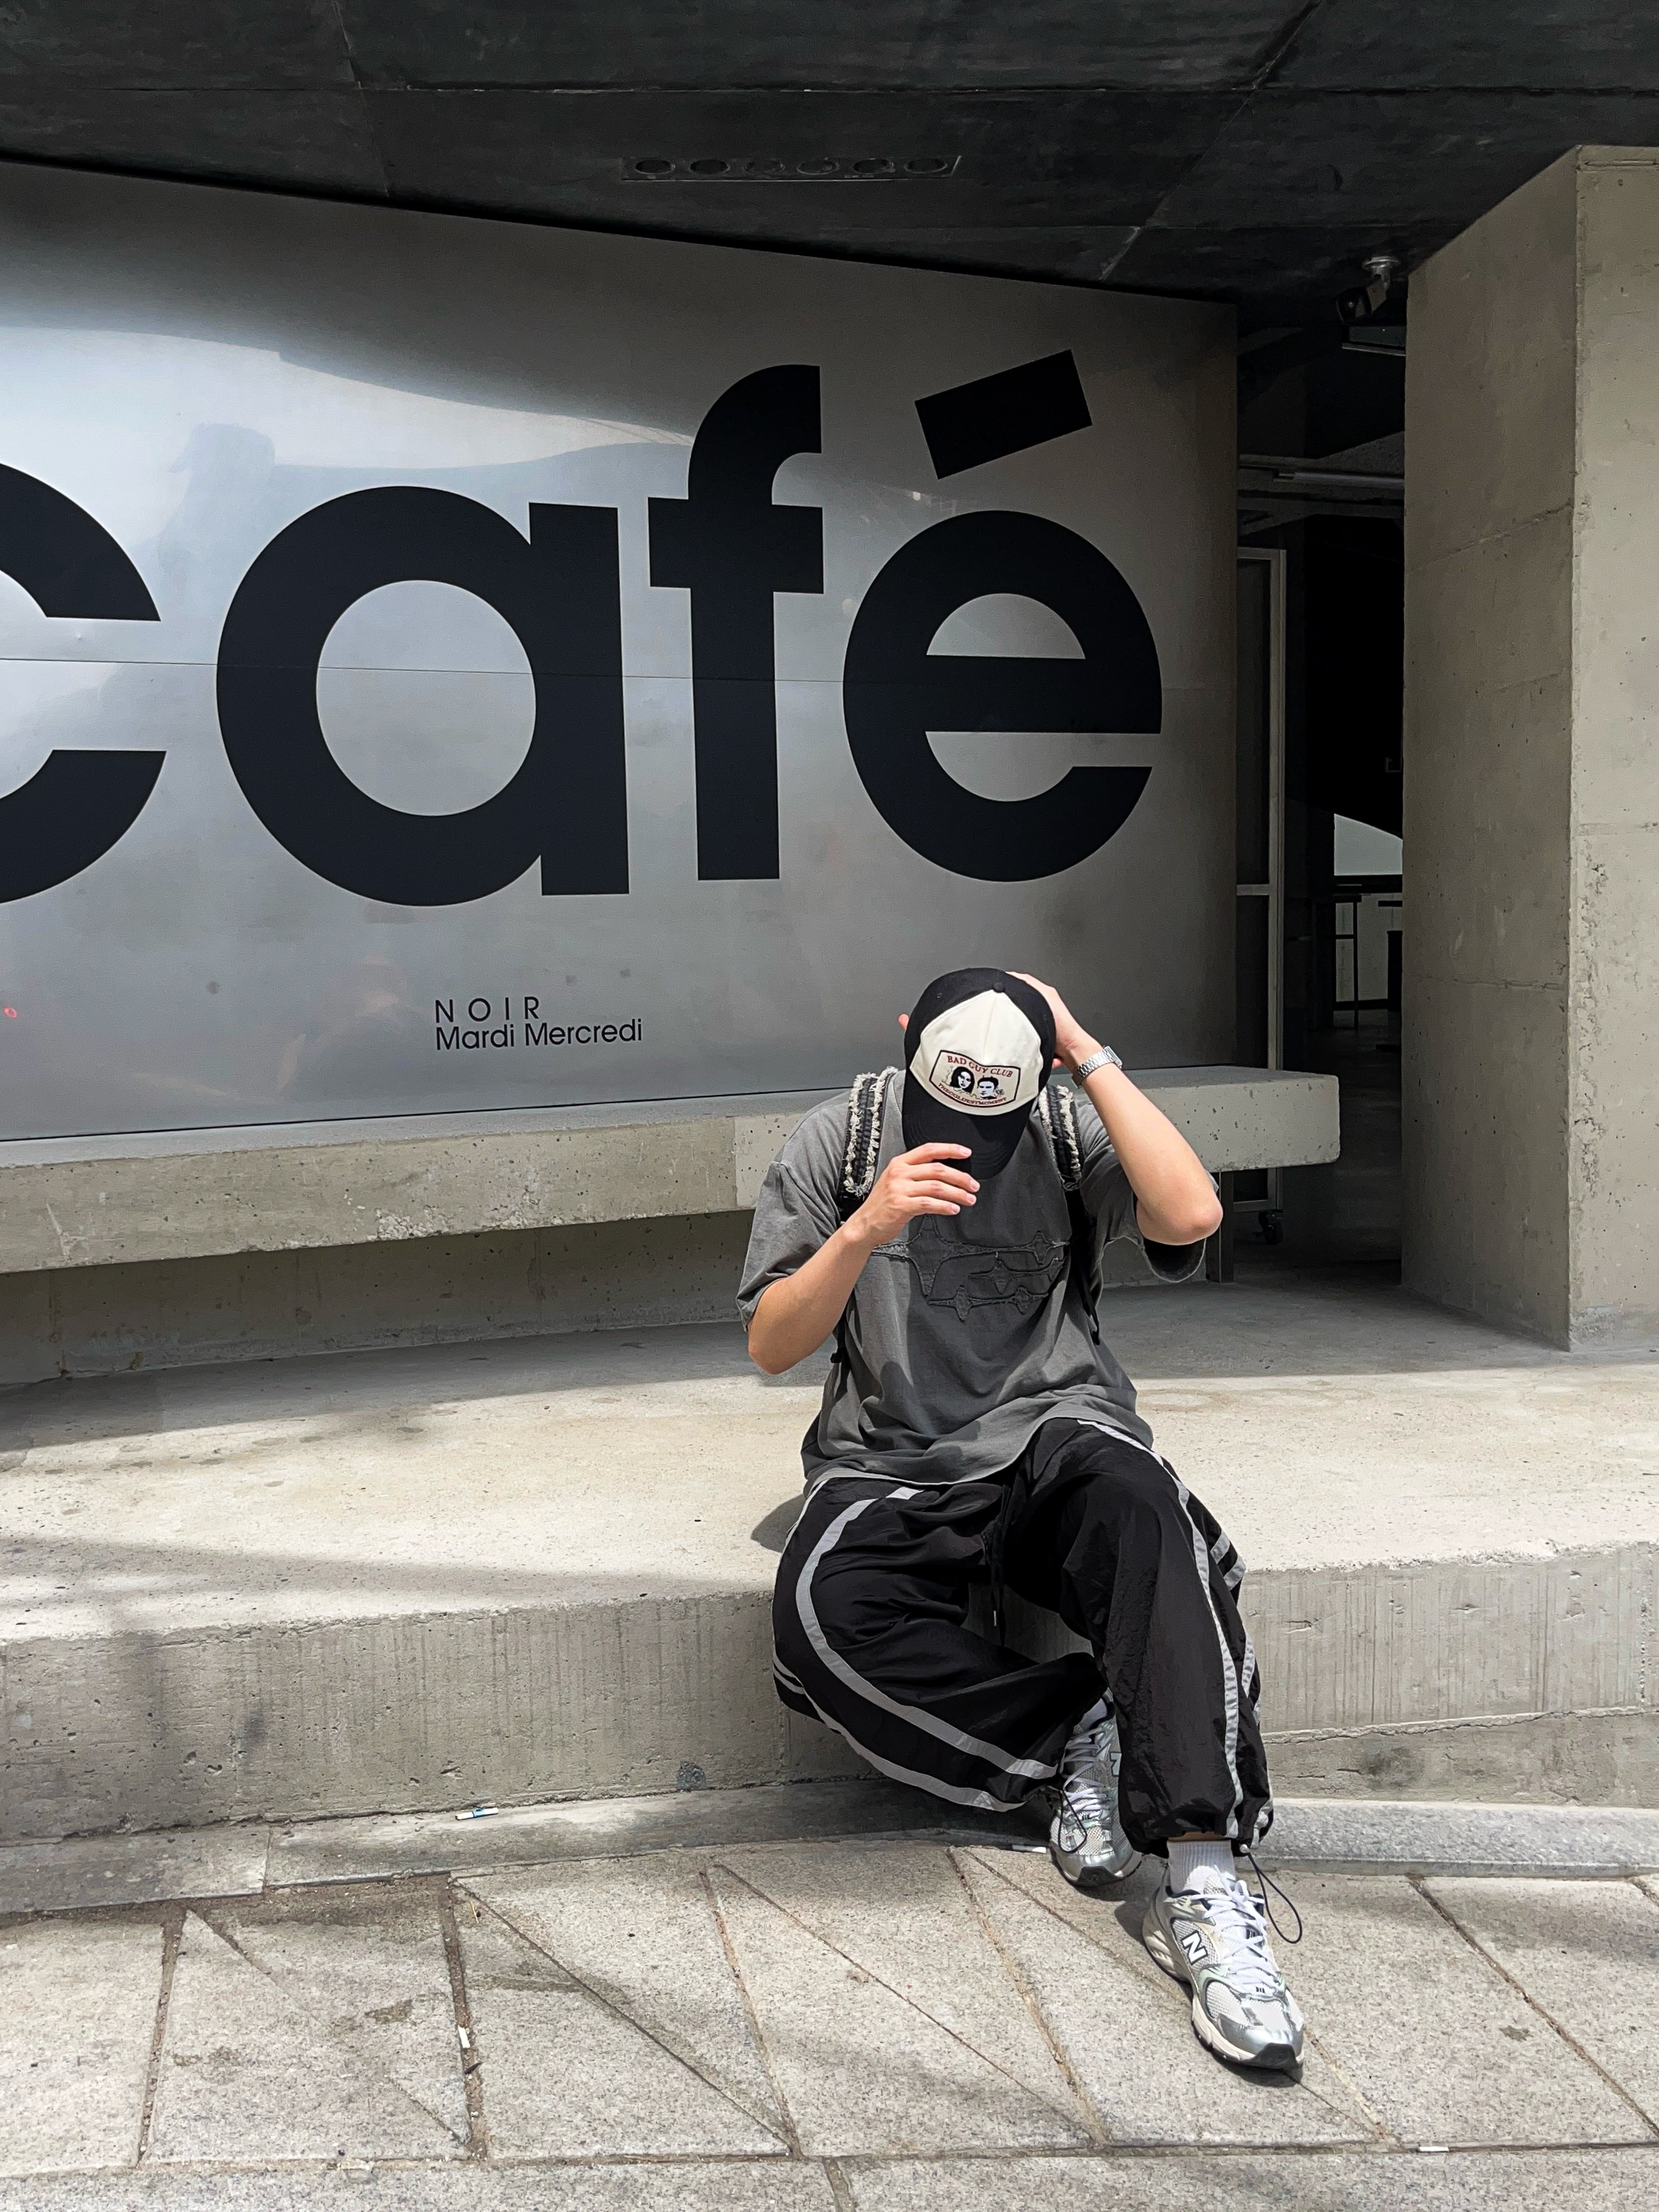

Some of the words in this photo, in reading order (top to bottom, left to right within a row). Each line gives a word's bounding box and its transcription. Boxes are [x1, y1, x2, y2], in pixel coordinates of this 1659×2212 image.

[435, 996, 540, 1023] NOIR
[436, 1024, 514, 1050] Mardi
[525, 1018, 642, 1046] Mercredi
[947, 1056, 966, 1064] BAD
[969, 1061, 988, 1073] GUY
[990, 1068, 1013, 1077] CLUB
[1181, 1930, 1208, 1965] N
